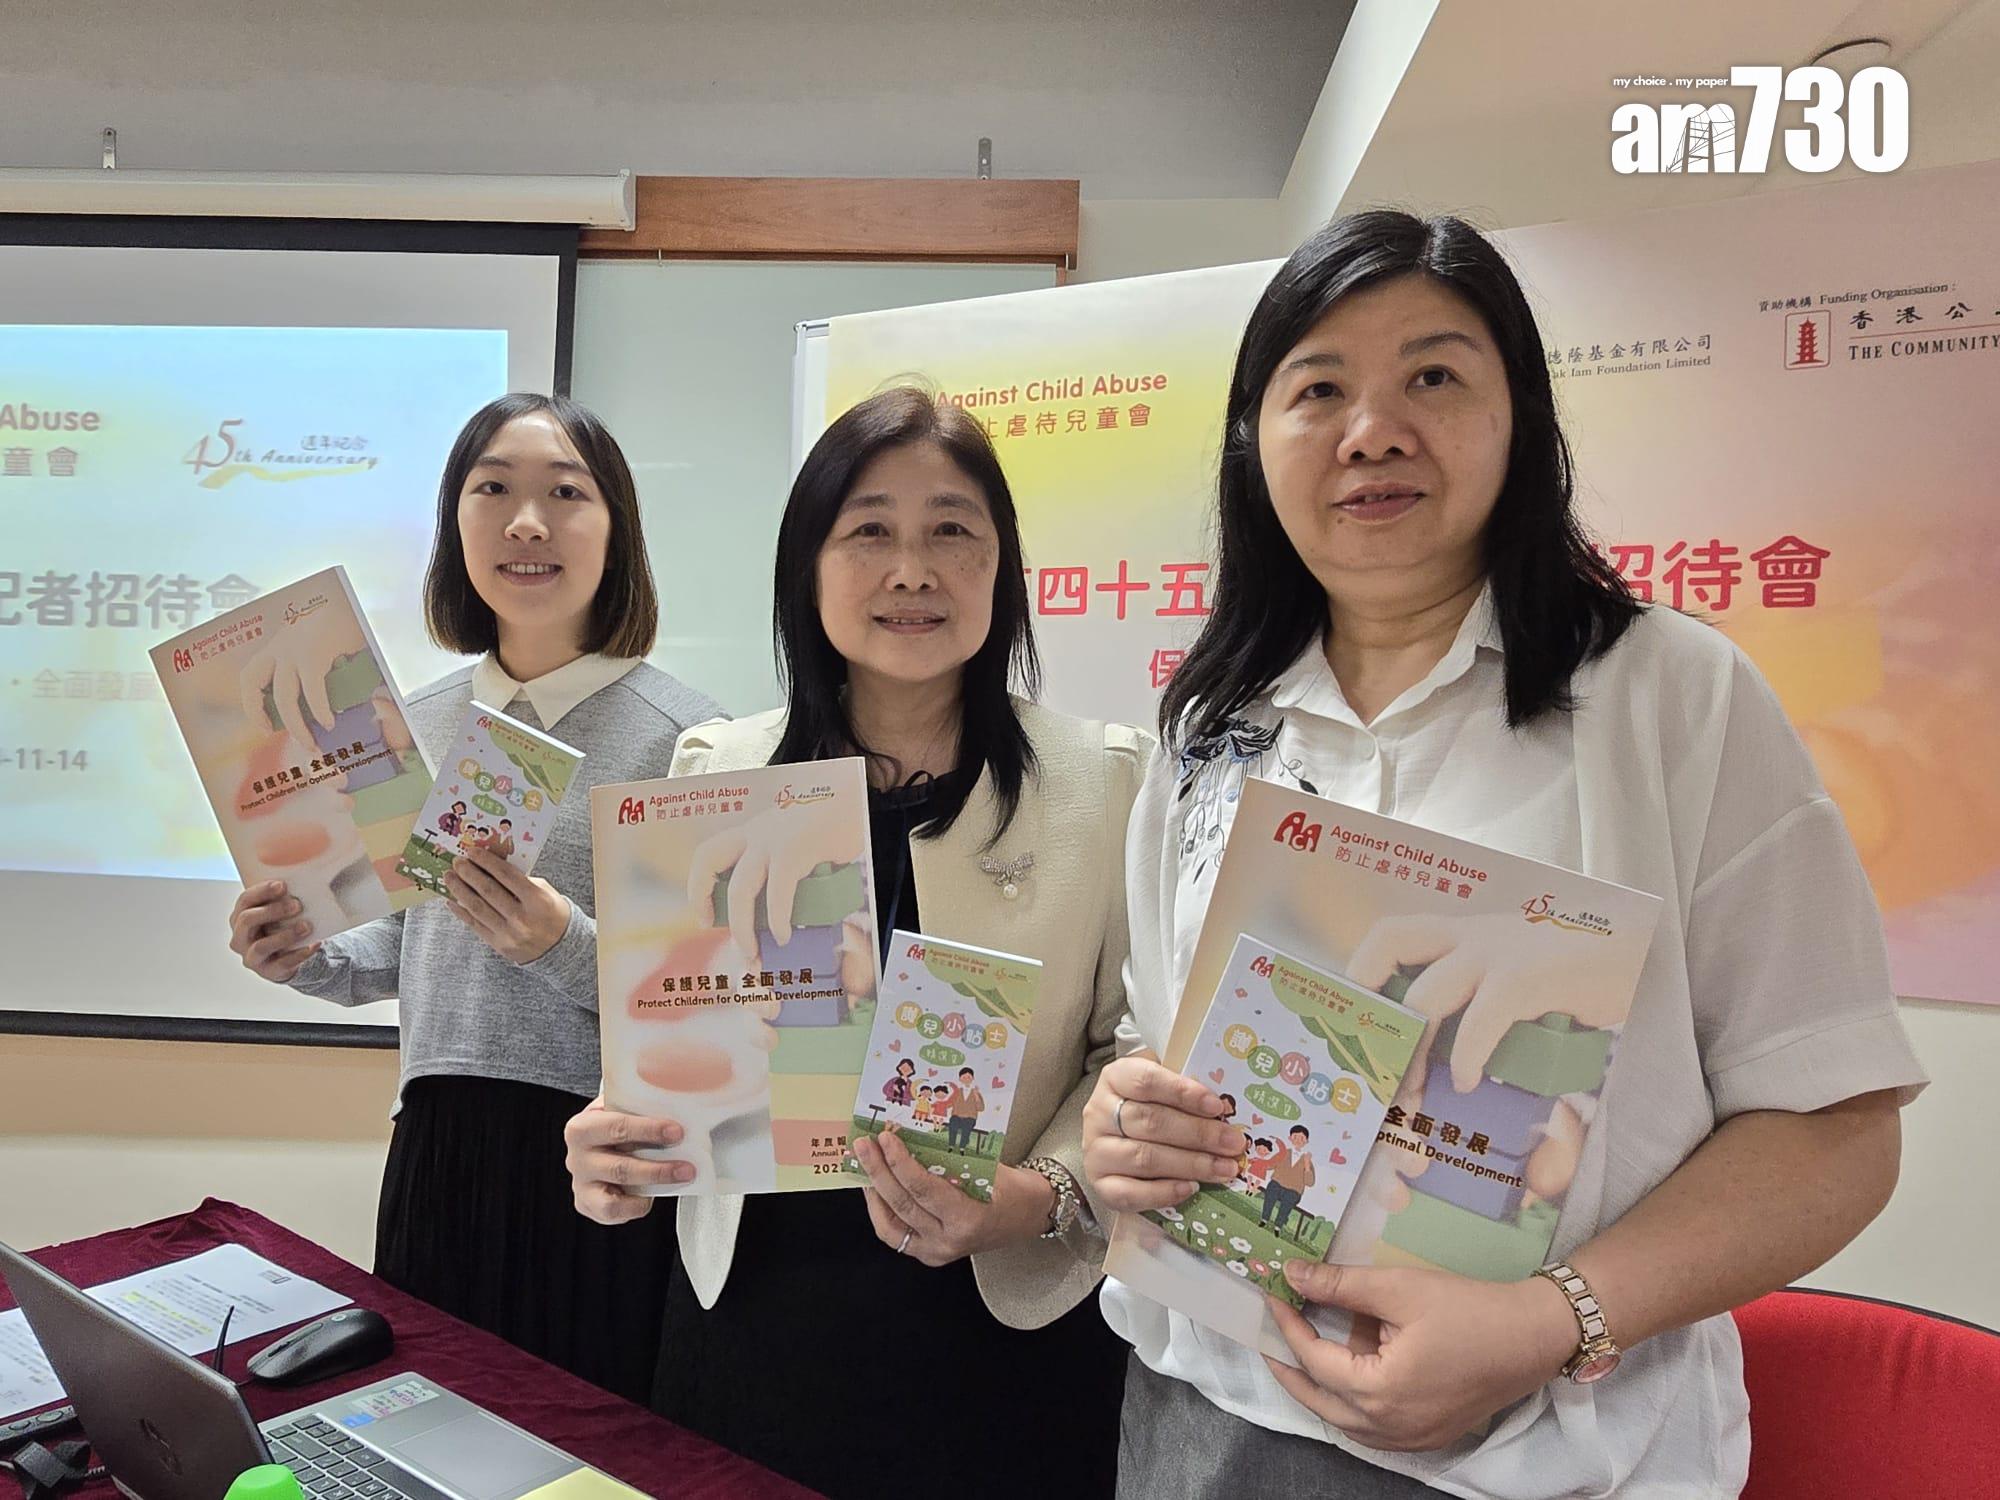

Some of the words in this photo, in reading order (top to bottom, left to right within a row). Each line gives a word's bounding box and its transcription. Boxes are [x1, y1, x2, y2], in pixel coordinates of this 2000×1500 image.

[1759, 296, 1813, 312] 資助機構
[1820, 292, 1867, 305] Funding
[1871, 284, 1948, 300] Organisation
[1850, 302, 2000, 329] 香港公
[1597, 361, 1662, 375] Foundation
[1666, 355, 1711, 369] Limited
[1849, 345, 1883, 360] THE
[937, 385, 1018, 409] Against
[1026, 377, 1083, 401] Child
[1092, 374, 1168, 396] Abuse
[0, 403, 101, 431] Abuse
[261, 449, 378, 469] Anniversary
[1024, 560, 1214, 620] 四十五
[192, 633, 219, 651] Against
[219, 624, 239, 639] Child
[240, 615, 263, 630] Abuse
[240, 797, 266, 812] Protect
[266, 784, 297, 801] Children
[297, 780, 308, 791] for
[309, 768, 339, 786] Optimal
[339, 749, 393, 773] Development
[650, 793, 686, 808] Against
[690, 789, 716, 802] Child
[718, 786, 749, 798] Abuse
[1330, 825, 1390, 852] Against
[1394, 844, 1434, 866] Child
[1437, 858, 1488, 882] Abuse
[1335, 846, 1473, 899] 防止虐待兒童會
[662, 974, 730, 993] 保護兒童
[742, 968, 813, 988] 全面發展
[1279, 966, 1308, 984] Against
[1309, 980, 1329, 994] Child
[1330, 989, 1354, 1007] Abuse
[638, 998, 672, 1009] Protect
[674, 995, 714, 1008] Children
[716, 994, 731, 1005] for
[734, 992, 773, 1006] Optimal
[775, 987, 844, 1002] Development
[1383, 1105, 1491, 1155] 全面發展
[811, 1149, 839, 1157] Annual
[1376, 1130, 1421, 1154] ptimal
[1424, 1145, 1524, 1188] Development
[814, 1163, 843, 1174] 202
